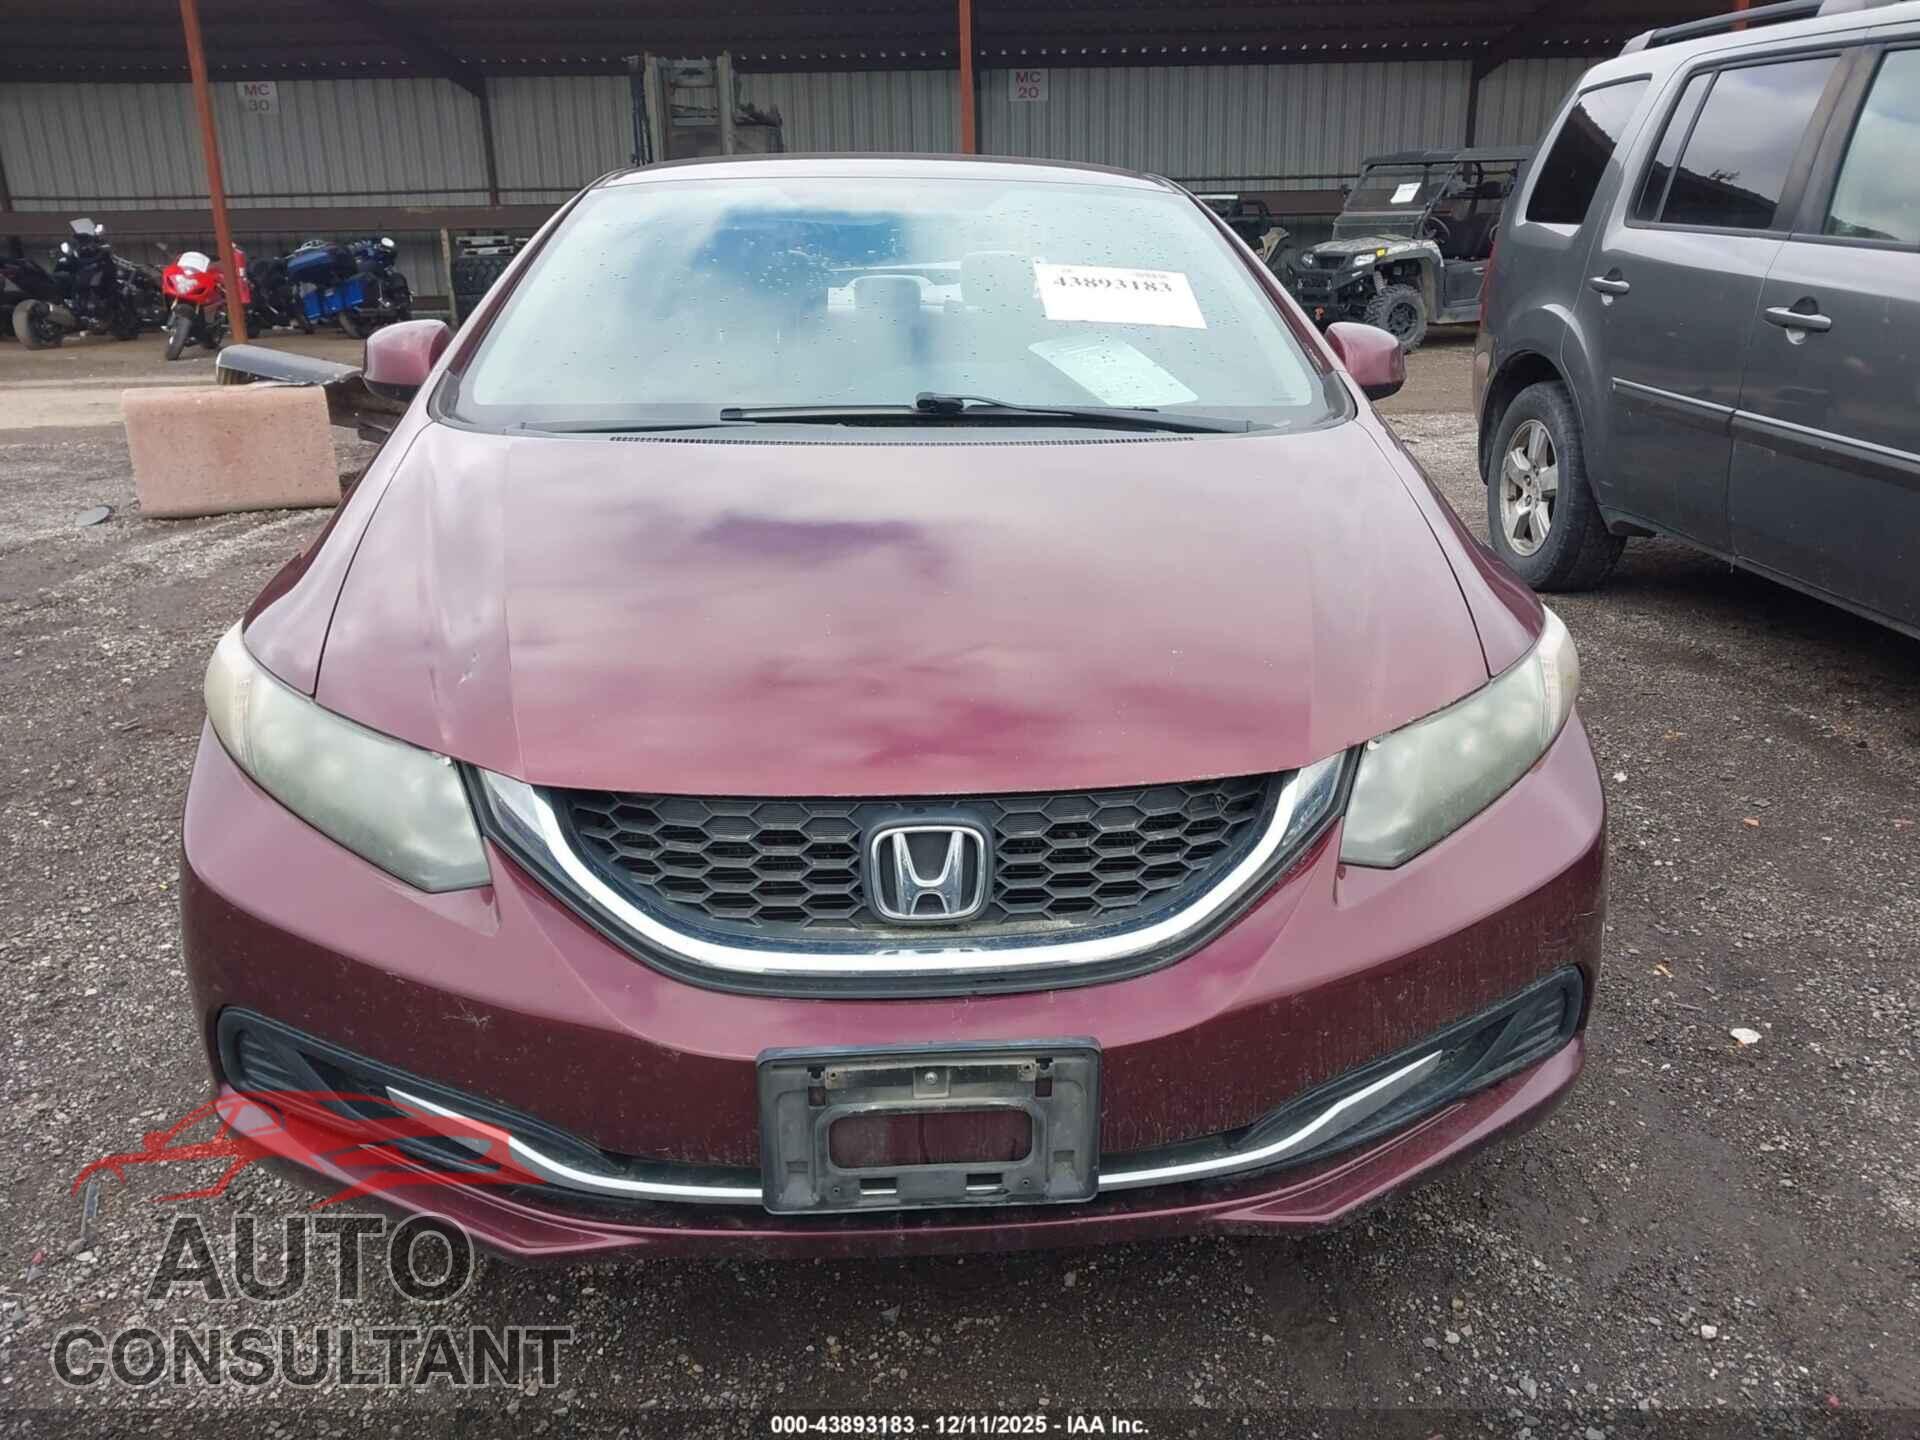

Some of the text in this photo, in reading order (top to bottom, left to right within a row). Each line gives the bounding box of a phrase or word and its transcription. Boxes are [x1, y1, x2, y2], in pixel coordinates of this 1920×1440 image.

[1015, 71, 1041, 83] MC
[243, 83, 271, 96] MC
[1018, 87, 1039, 99] 20
